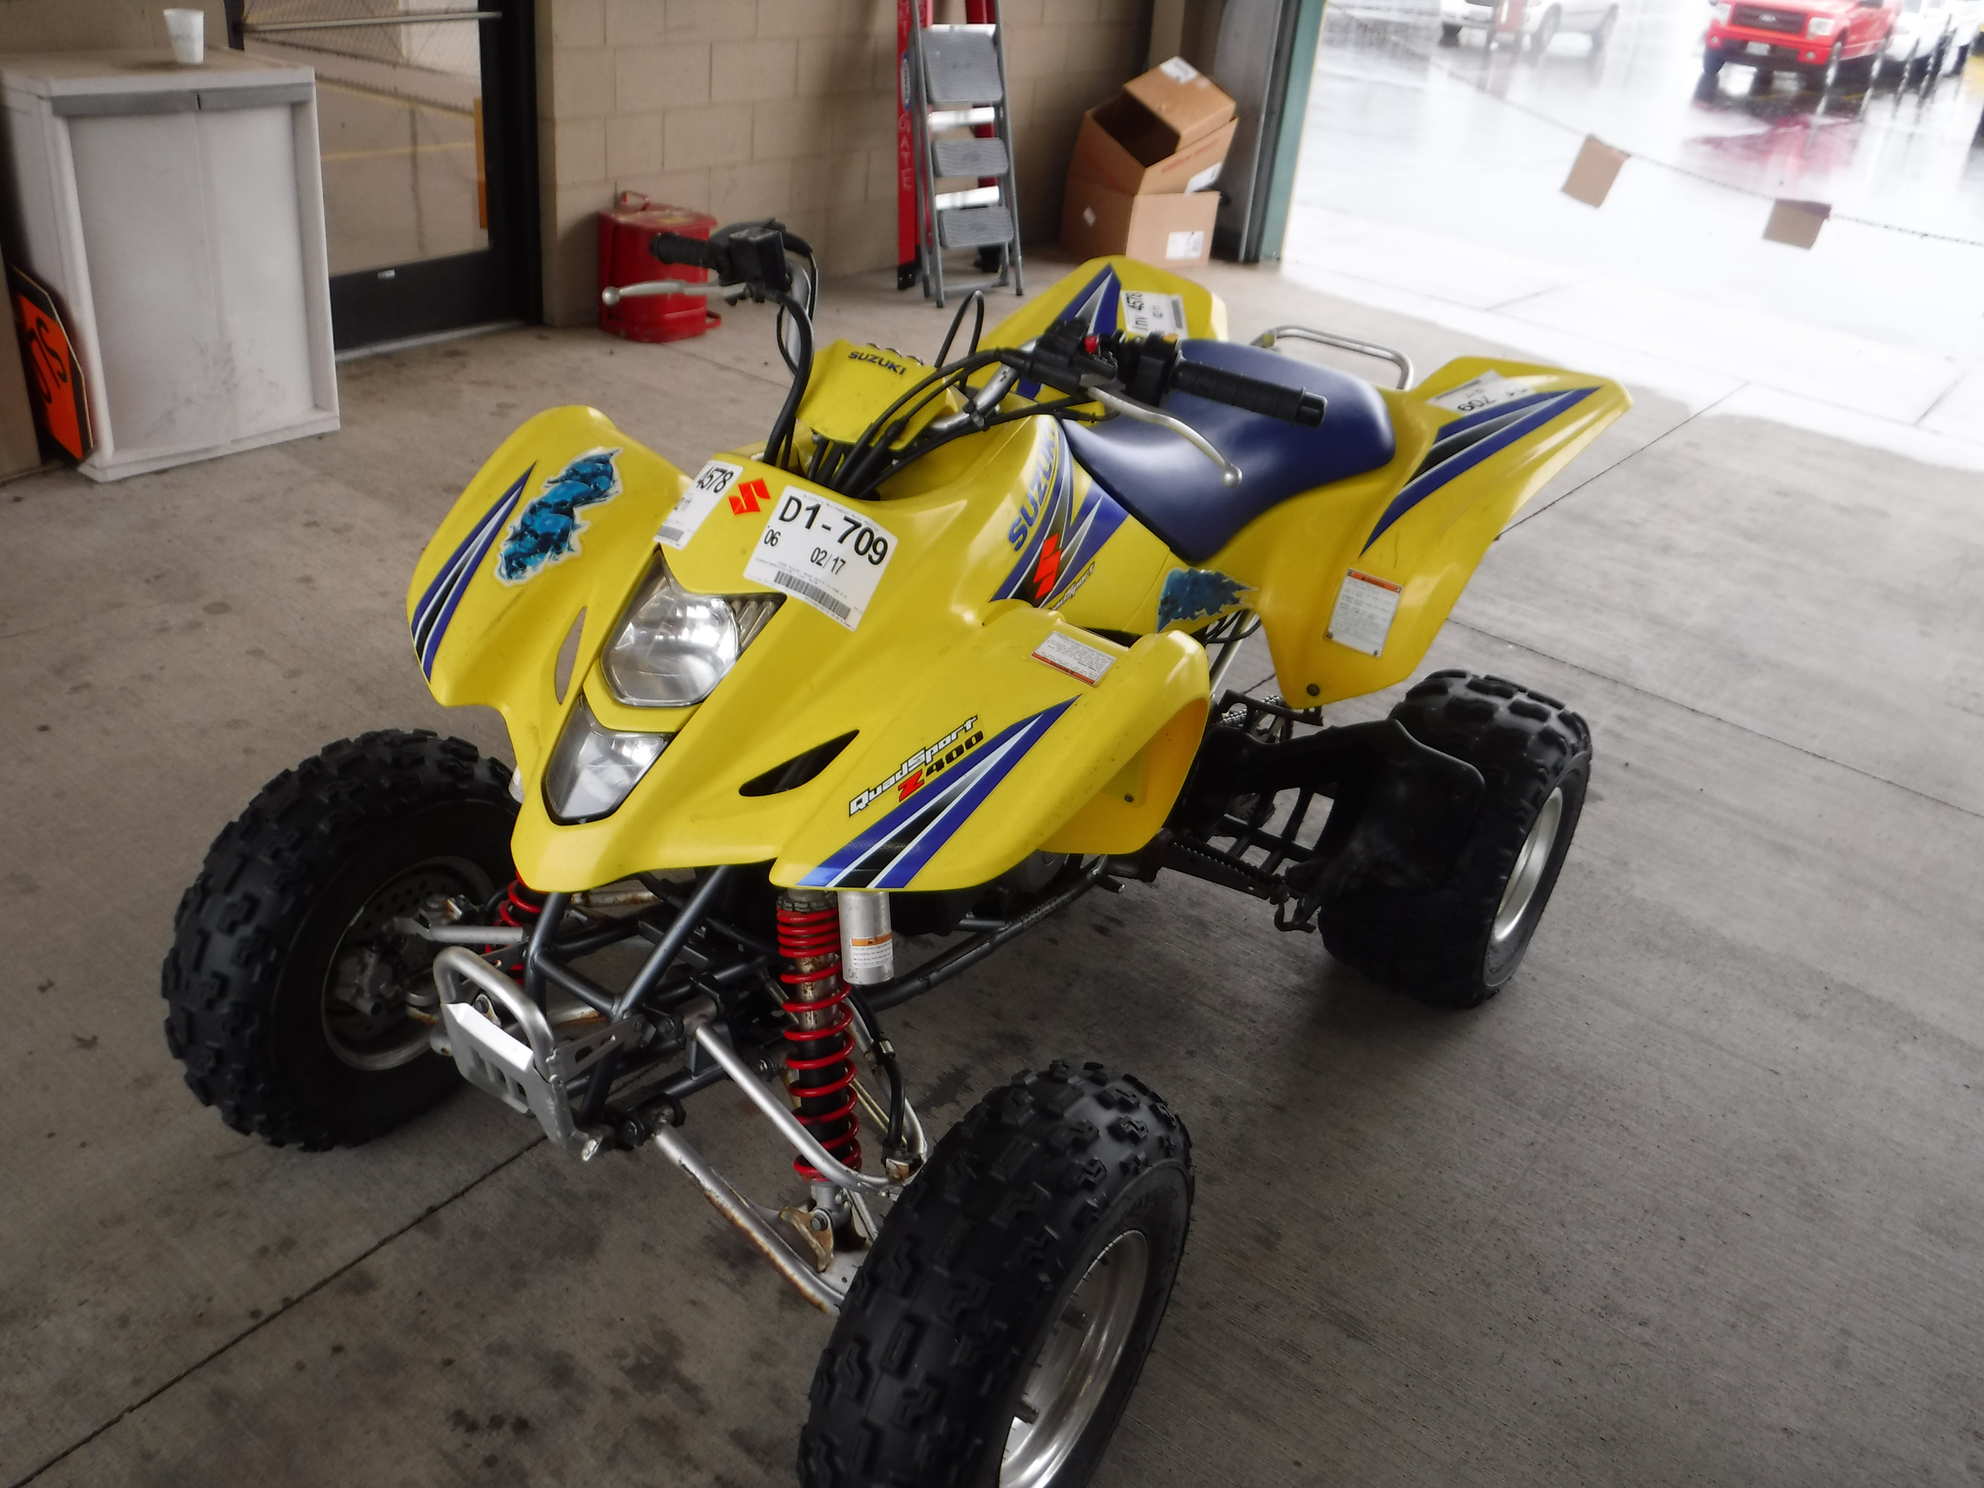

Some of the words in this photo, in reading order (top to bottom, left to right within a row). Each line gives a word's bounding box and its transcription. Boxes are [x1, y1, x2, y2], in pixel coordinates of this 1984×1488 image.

[848, 351, 907, 376] SUZUKI
[849, 714, 979, 817] QuadSport
[898, 730, 984, 802] Z400
